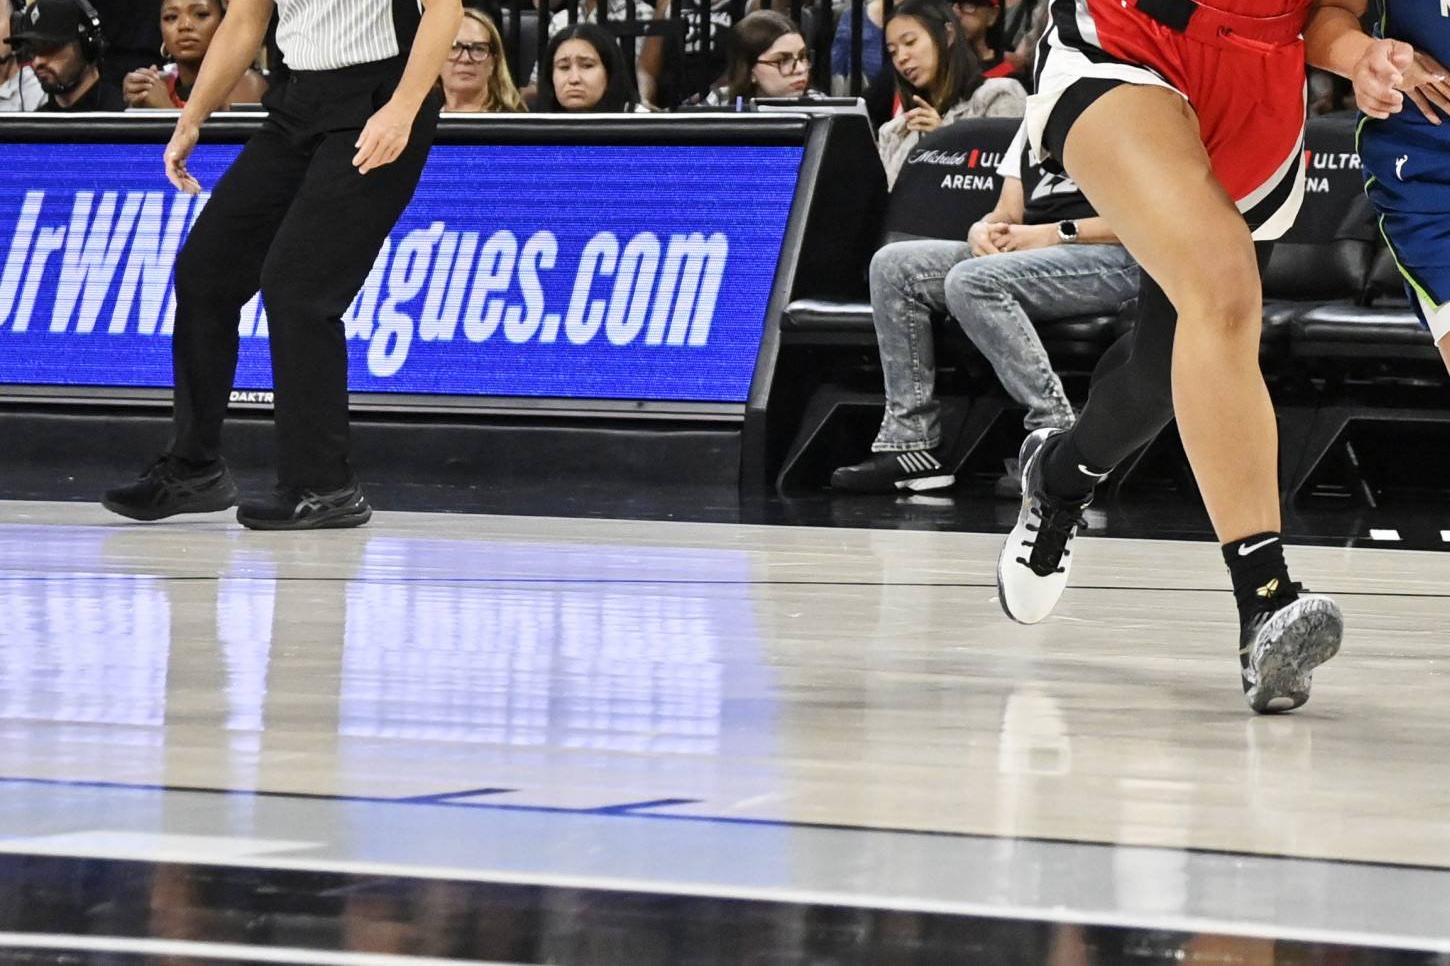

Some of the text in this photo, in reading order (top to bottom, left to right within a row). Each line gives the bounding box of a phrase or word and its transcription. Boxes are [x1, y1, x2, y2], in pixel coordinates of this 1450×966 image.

[907, 148, 968, 166] Michelob
[1313, 152, 1363, 169] ULTR
[940, 174, 995, 191] ARENA
[229, 391, 275, 403] DAKTR
